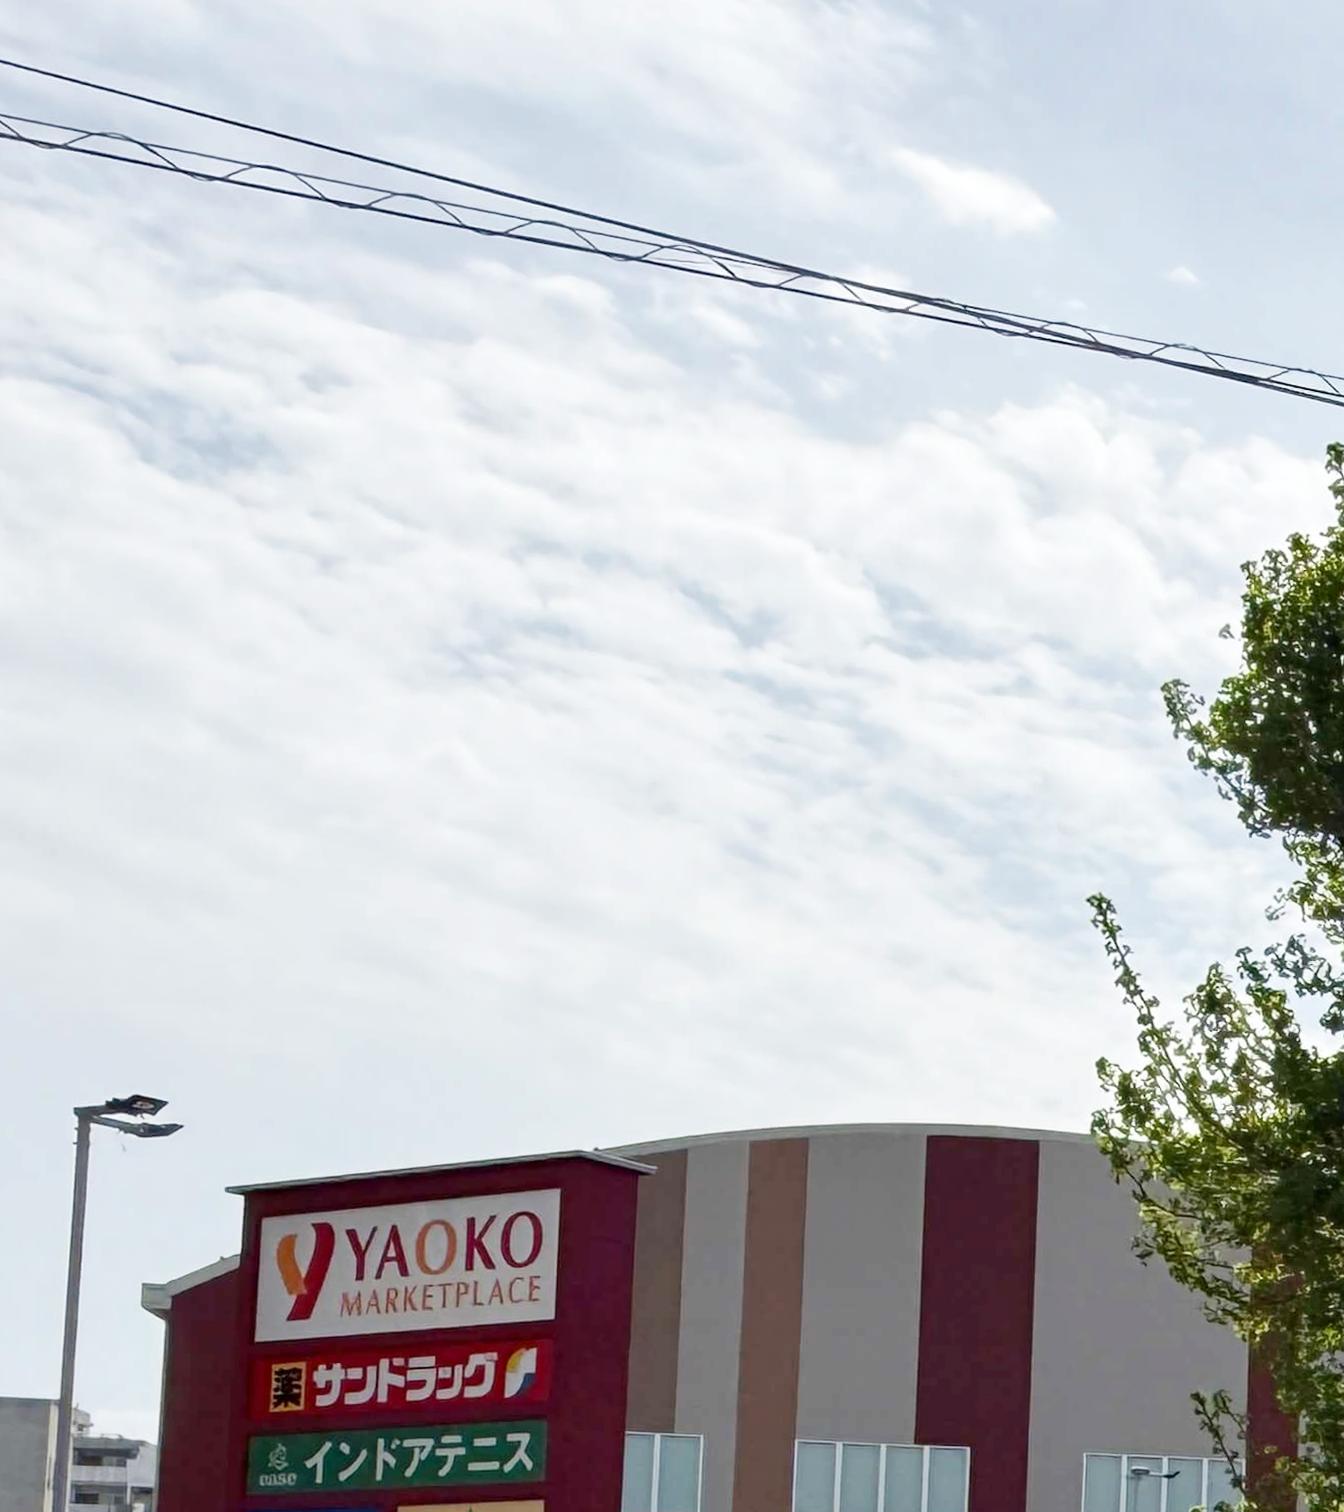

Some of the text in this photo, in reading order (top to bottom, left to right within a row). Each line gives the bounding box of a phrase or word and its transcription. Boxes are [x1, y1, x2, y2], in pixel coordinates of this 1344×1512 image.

[345, 1211, 543, 1281] YAOKO
[340, 1275, 541, 1317] MARKETPLACE
[313, 1352, 498, 1407] サンドラッグ
[304, 1432, 534, 1484] インドアテニス
